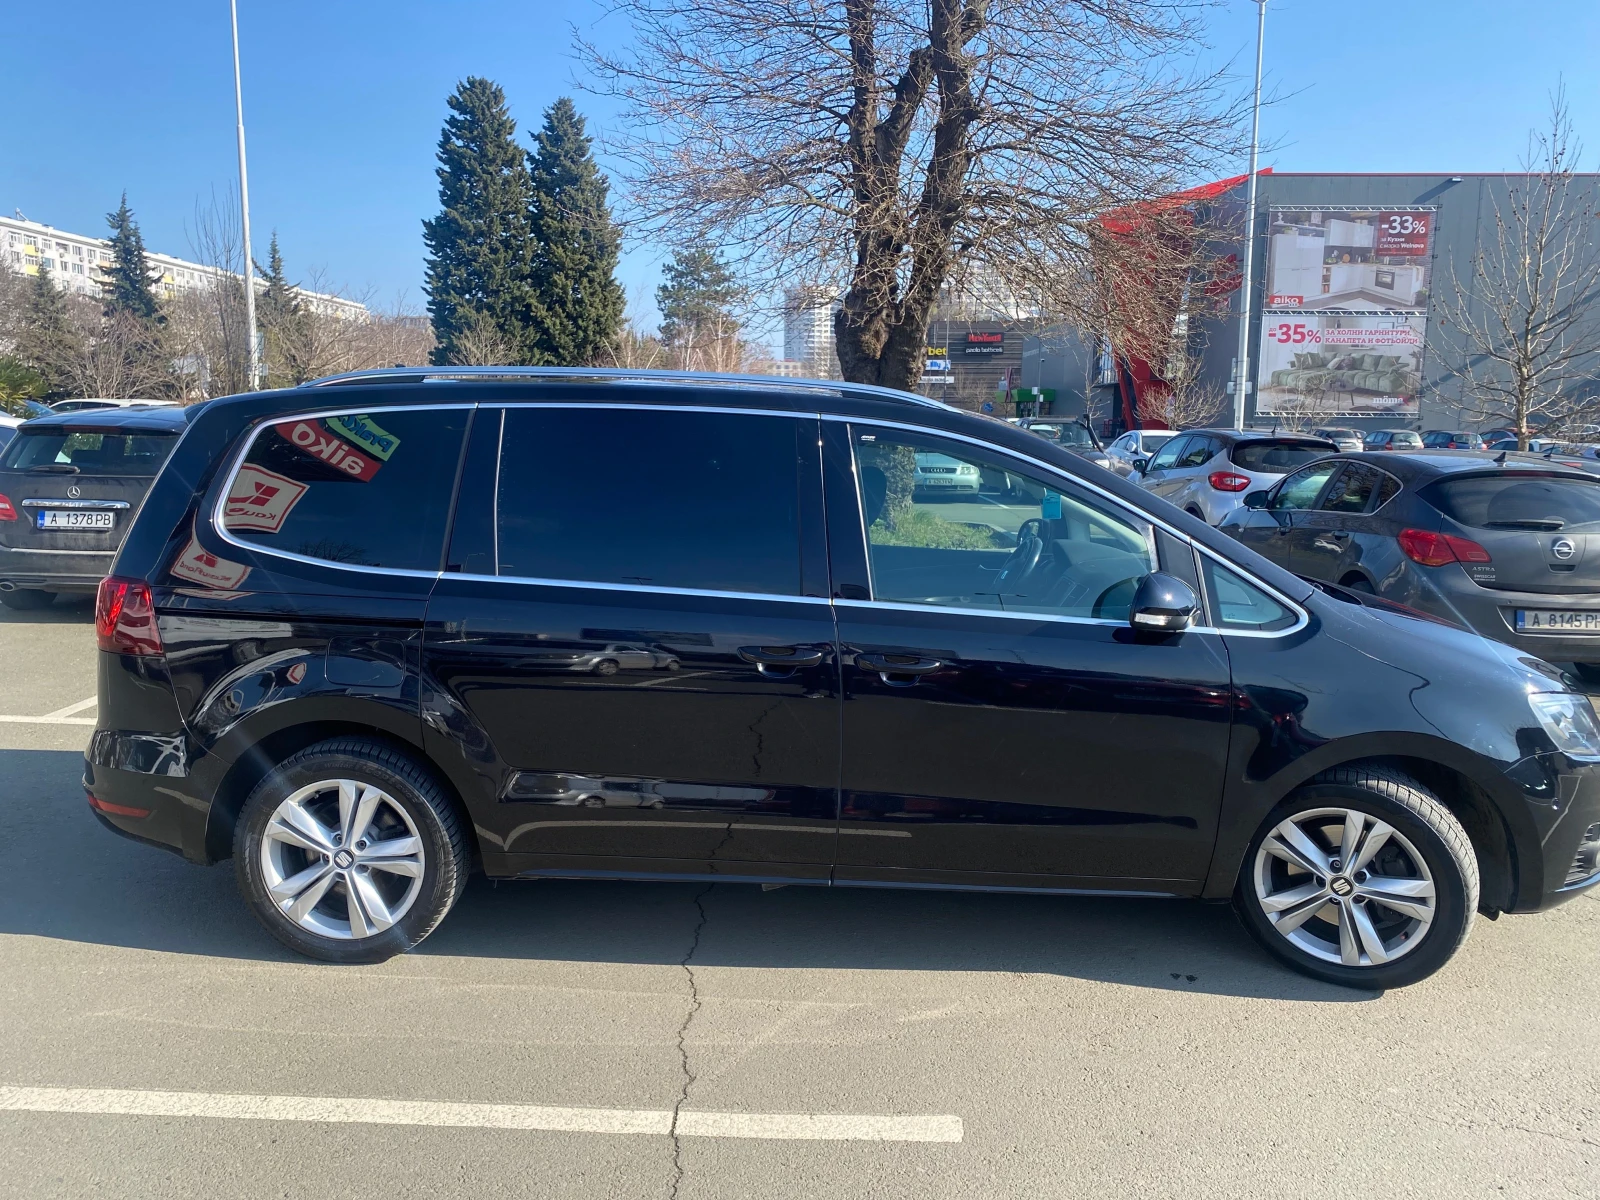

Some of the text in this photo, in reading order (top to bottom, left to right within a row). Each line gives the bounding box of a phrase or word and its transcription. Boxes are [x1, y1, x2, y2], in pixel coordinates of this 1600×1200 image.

[1381, 215, 1426, 234] -33%
[1273, 295, 1299, 304] aiko
[1268, 323, 1322, 344] -35%
